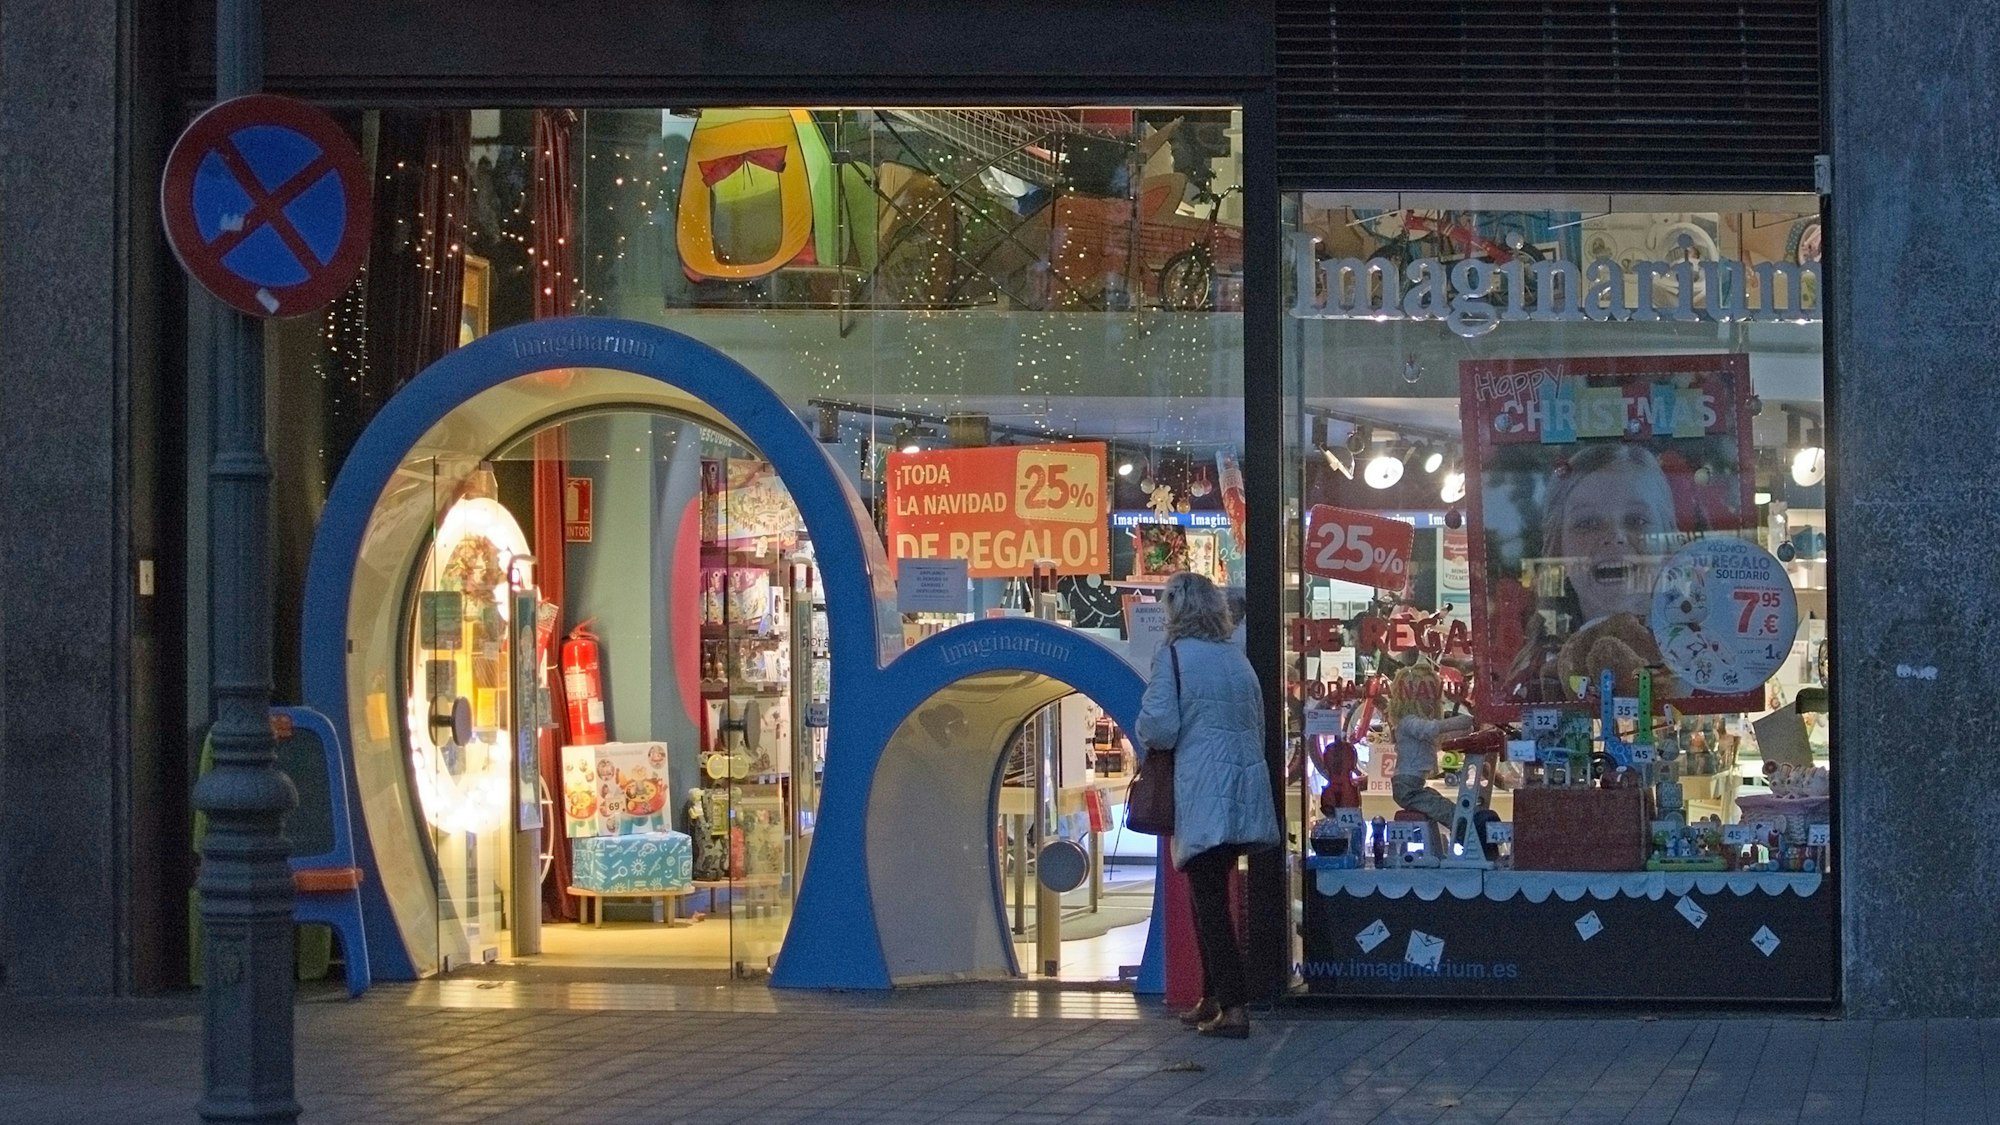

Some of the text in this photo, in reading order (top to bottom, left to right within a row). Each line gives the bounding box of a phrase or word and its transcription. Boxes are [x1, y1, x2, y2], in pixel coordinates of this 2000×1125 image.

[1289, 232, 1821, 338] Imaginarium
[512, 329, 656, 359] Imaginarium
[1499, 394, 1717, 433] CHRISTMAS
[896, 463, 1094, 510] ¡TODA -25%
[896, 492, 1007, 516] LA NAVIDAD
[951, 528, 1099, 569] REGALO!
[1311, 523, 1404, 574] -25%
[1712, 554, 1770, 570] REGALO
[1716, 569, 1770, 580] SOLIDARIO
[1292, 617, 1341, 652] DE
[939, 630, 1070, 665] Imaginarium
[1537, 716, 1551, 726] 32
[1617, 706, 1631, 716] 35
[1635, 750, 1648, 760] 45
[1370, 781, 1383, 791] DE
[608, 802, 620, 811] 69
[1728, 830, 1741, 840] 45
[1813, 834, 1826, 844] 25
